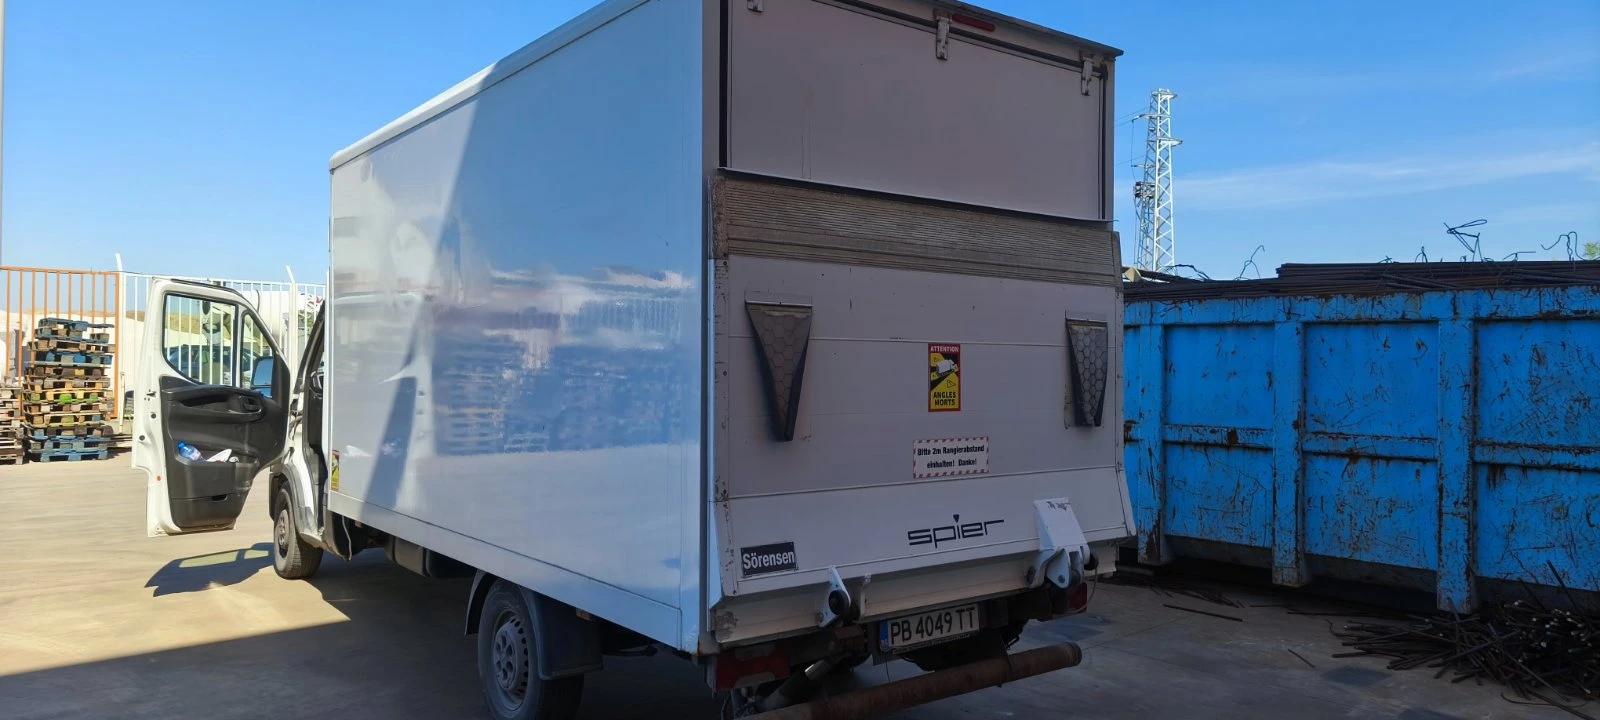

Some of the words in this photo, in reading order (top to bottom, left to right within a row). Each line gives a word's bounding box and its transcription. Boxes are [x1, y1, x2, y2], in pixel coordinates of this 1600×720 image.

[930, 345, 960, 353] ATTENTION
[933, 391, 957, 399] ANGLES
[934, 399, 956, 407] MORTS
[917, 447, 931, 456] Bitte
[932, 447, 942, 455] 2m
[942, 444, 985, 456] Rangierabstand
[926, 460, 955, 469] einhalten!
[958, 458, 977, 467] Danke!
[907, 513, 1005, 549] spier
[742, 551, 795, 570] Sörensen
[890, 620, 912, 645] PB
[915, 612, 953, 639] 4049
[955, 606, 975, 631] TT
